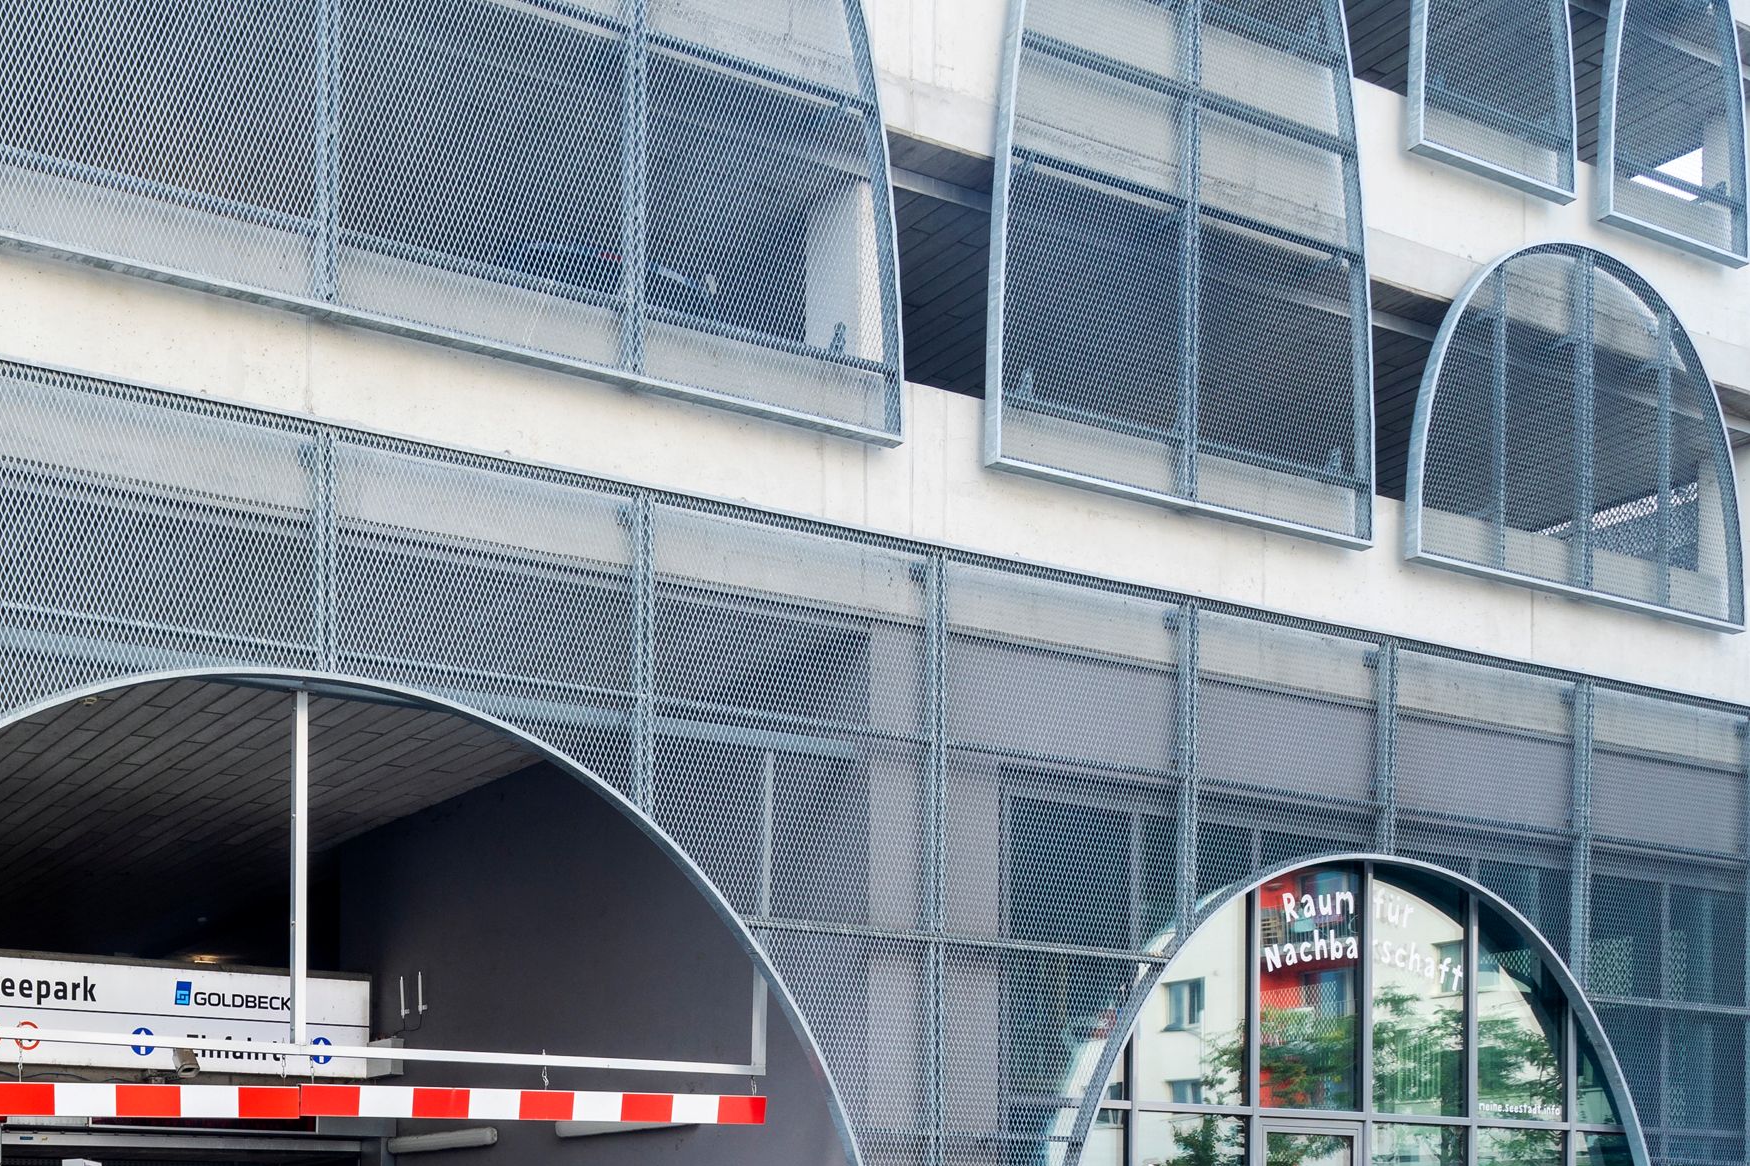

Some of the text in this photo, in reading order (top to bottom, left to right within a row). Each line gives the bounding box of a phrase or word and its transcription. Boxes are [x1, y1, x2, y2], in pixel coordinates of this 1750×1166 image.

[1282, 887, 1415, 929] Raum für
[1264, 929, 1464, 992] Nachbaschaft
[193, 991, 291, 1011] GOLDBECK
